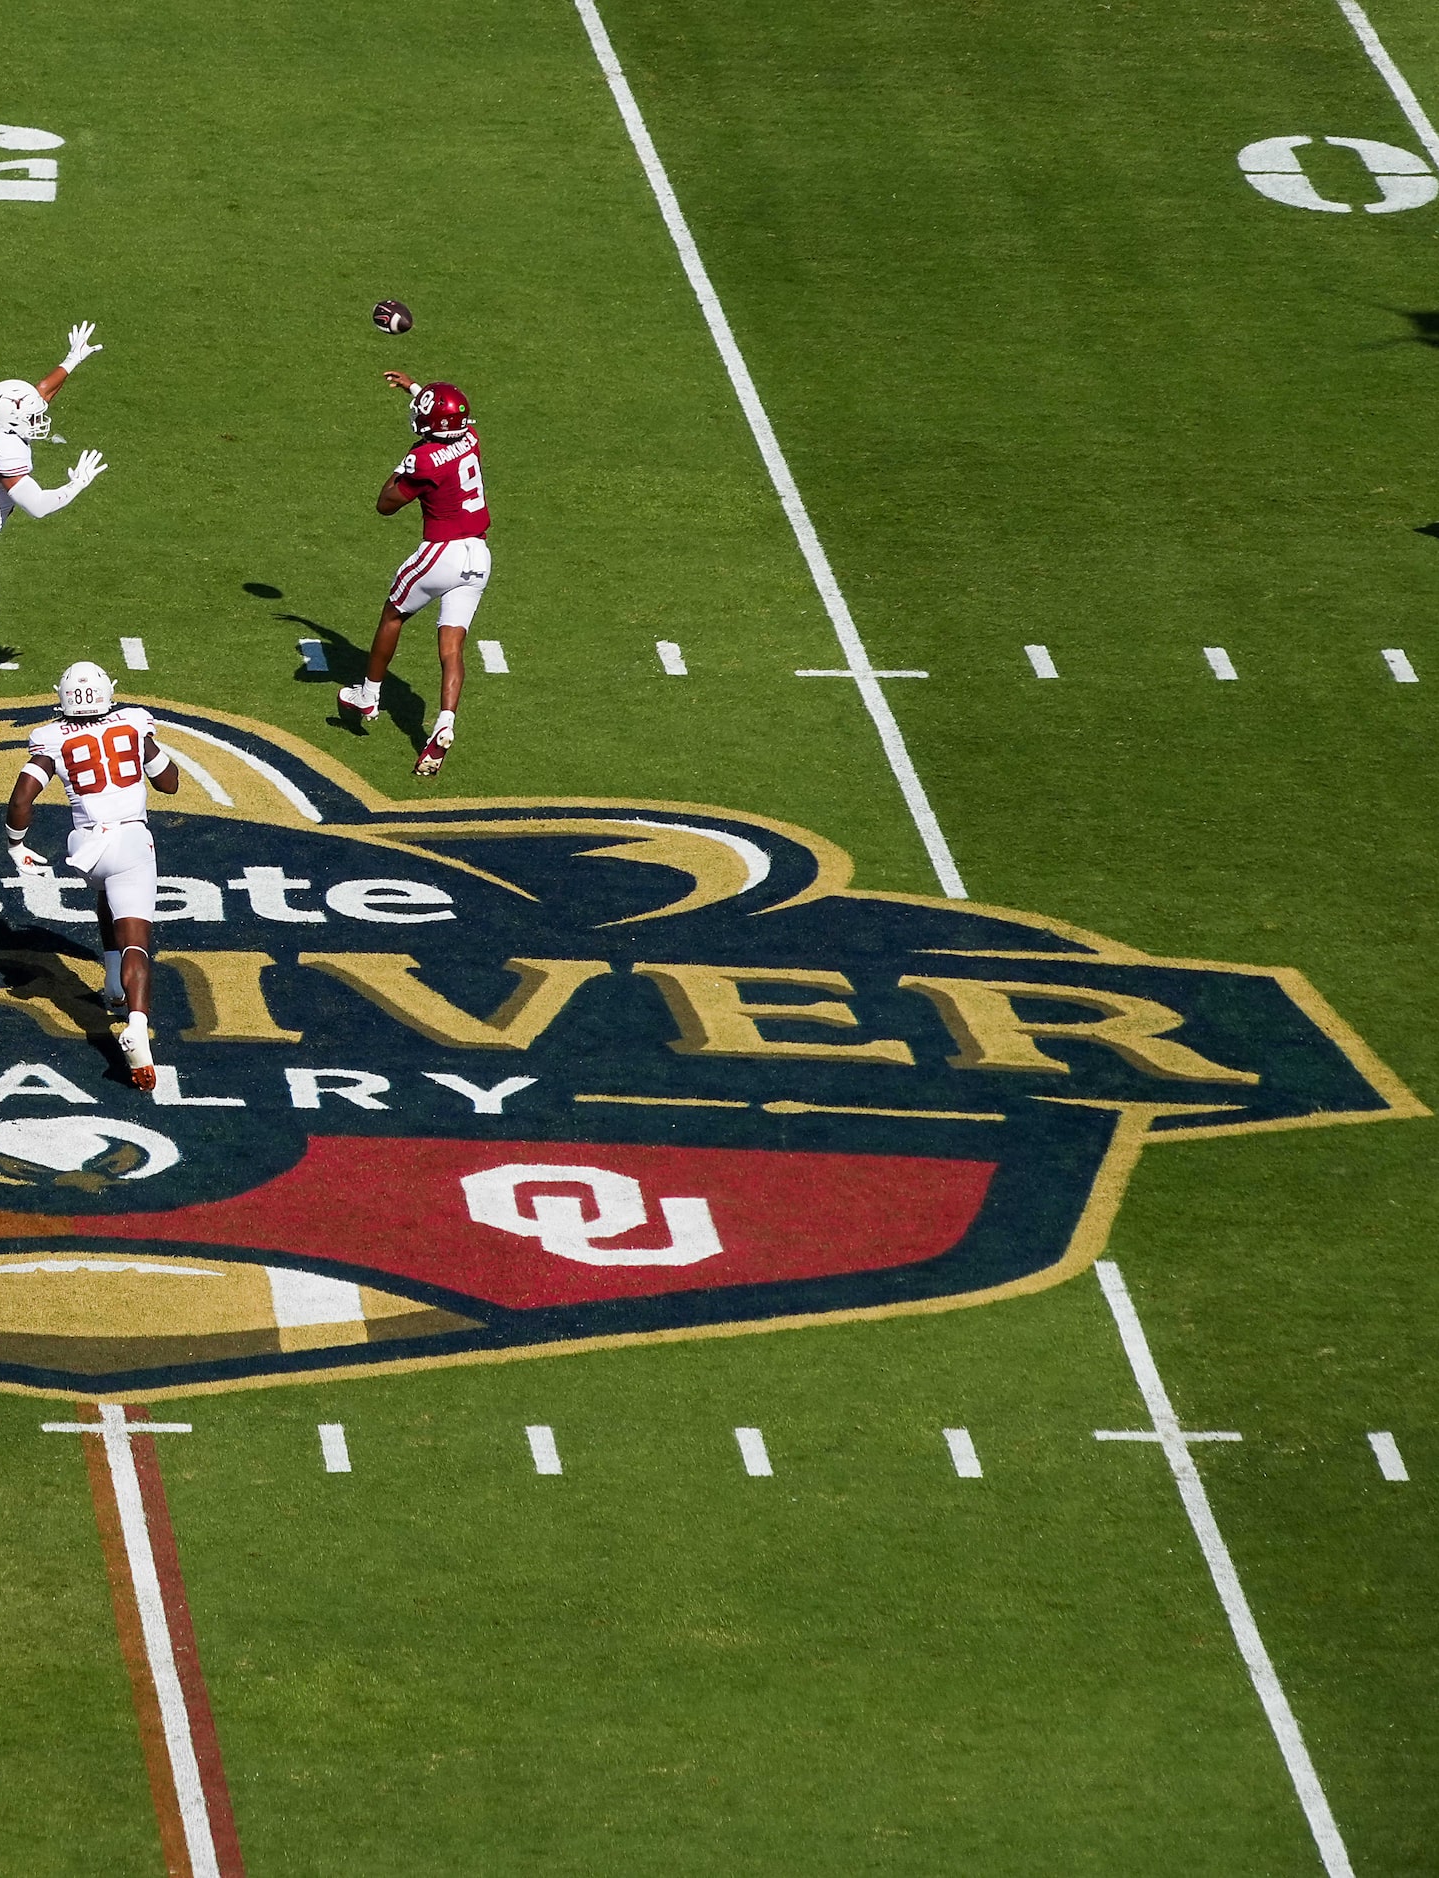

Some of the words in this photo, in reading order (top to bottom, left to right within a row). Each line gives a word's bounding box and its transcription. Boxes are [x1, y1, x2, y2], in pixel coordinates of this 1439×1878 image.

[405, 454, 417, 474] 9
[458, 453, 486, 513] 9
[74, 687, 94, 705] 88
[60, 724, 143, 797] 88
[459, 1164, 724, 1267] OU
